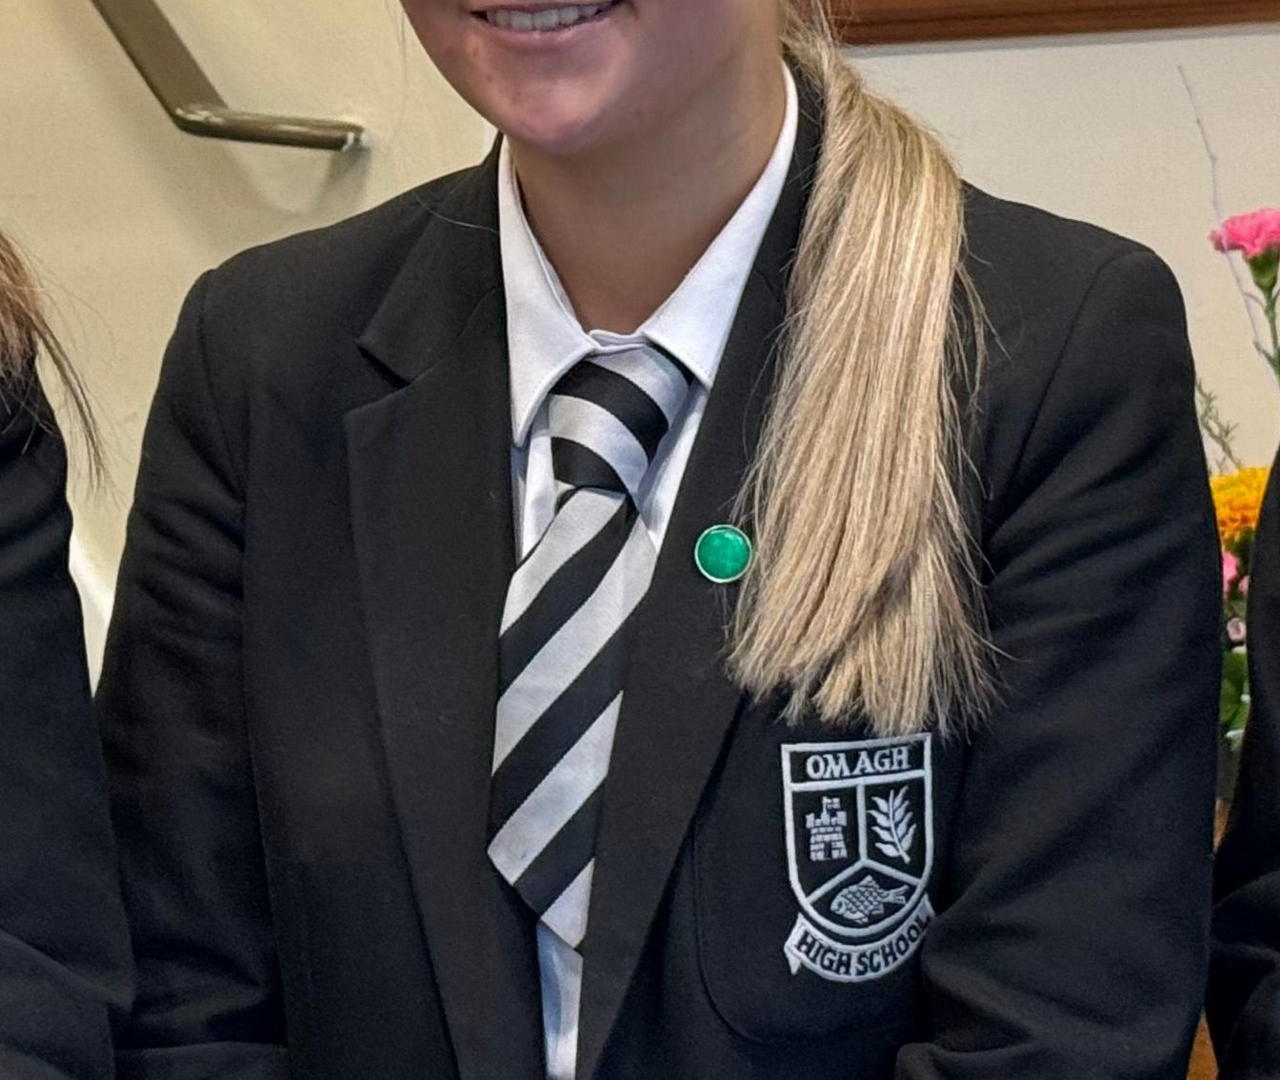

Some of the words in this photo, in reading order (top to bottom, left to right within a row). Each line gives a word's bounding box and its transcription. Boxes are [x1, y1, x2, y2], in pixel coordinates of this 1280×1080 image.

[806, 747, 910, 779] OMAGH
[794, 929, 853, 976] HIGH
[854, 913, 932, 977] SCHOOL
